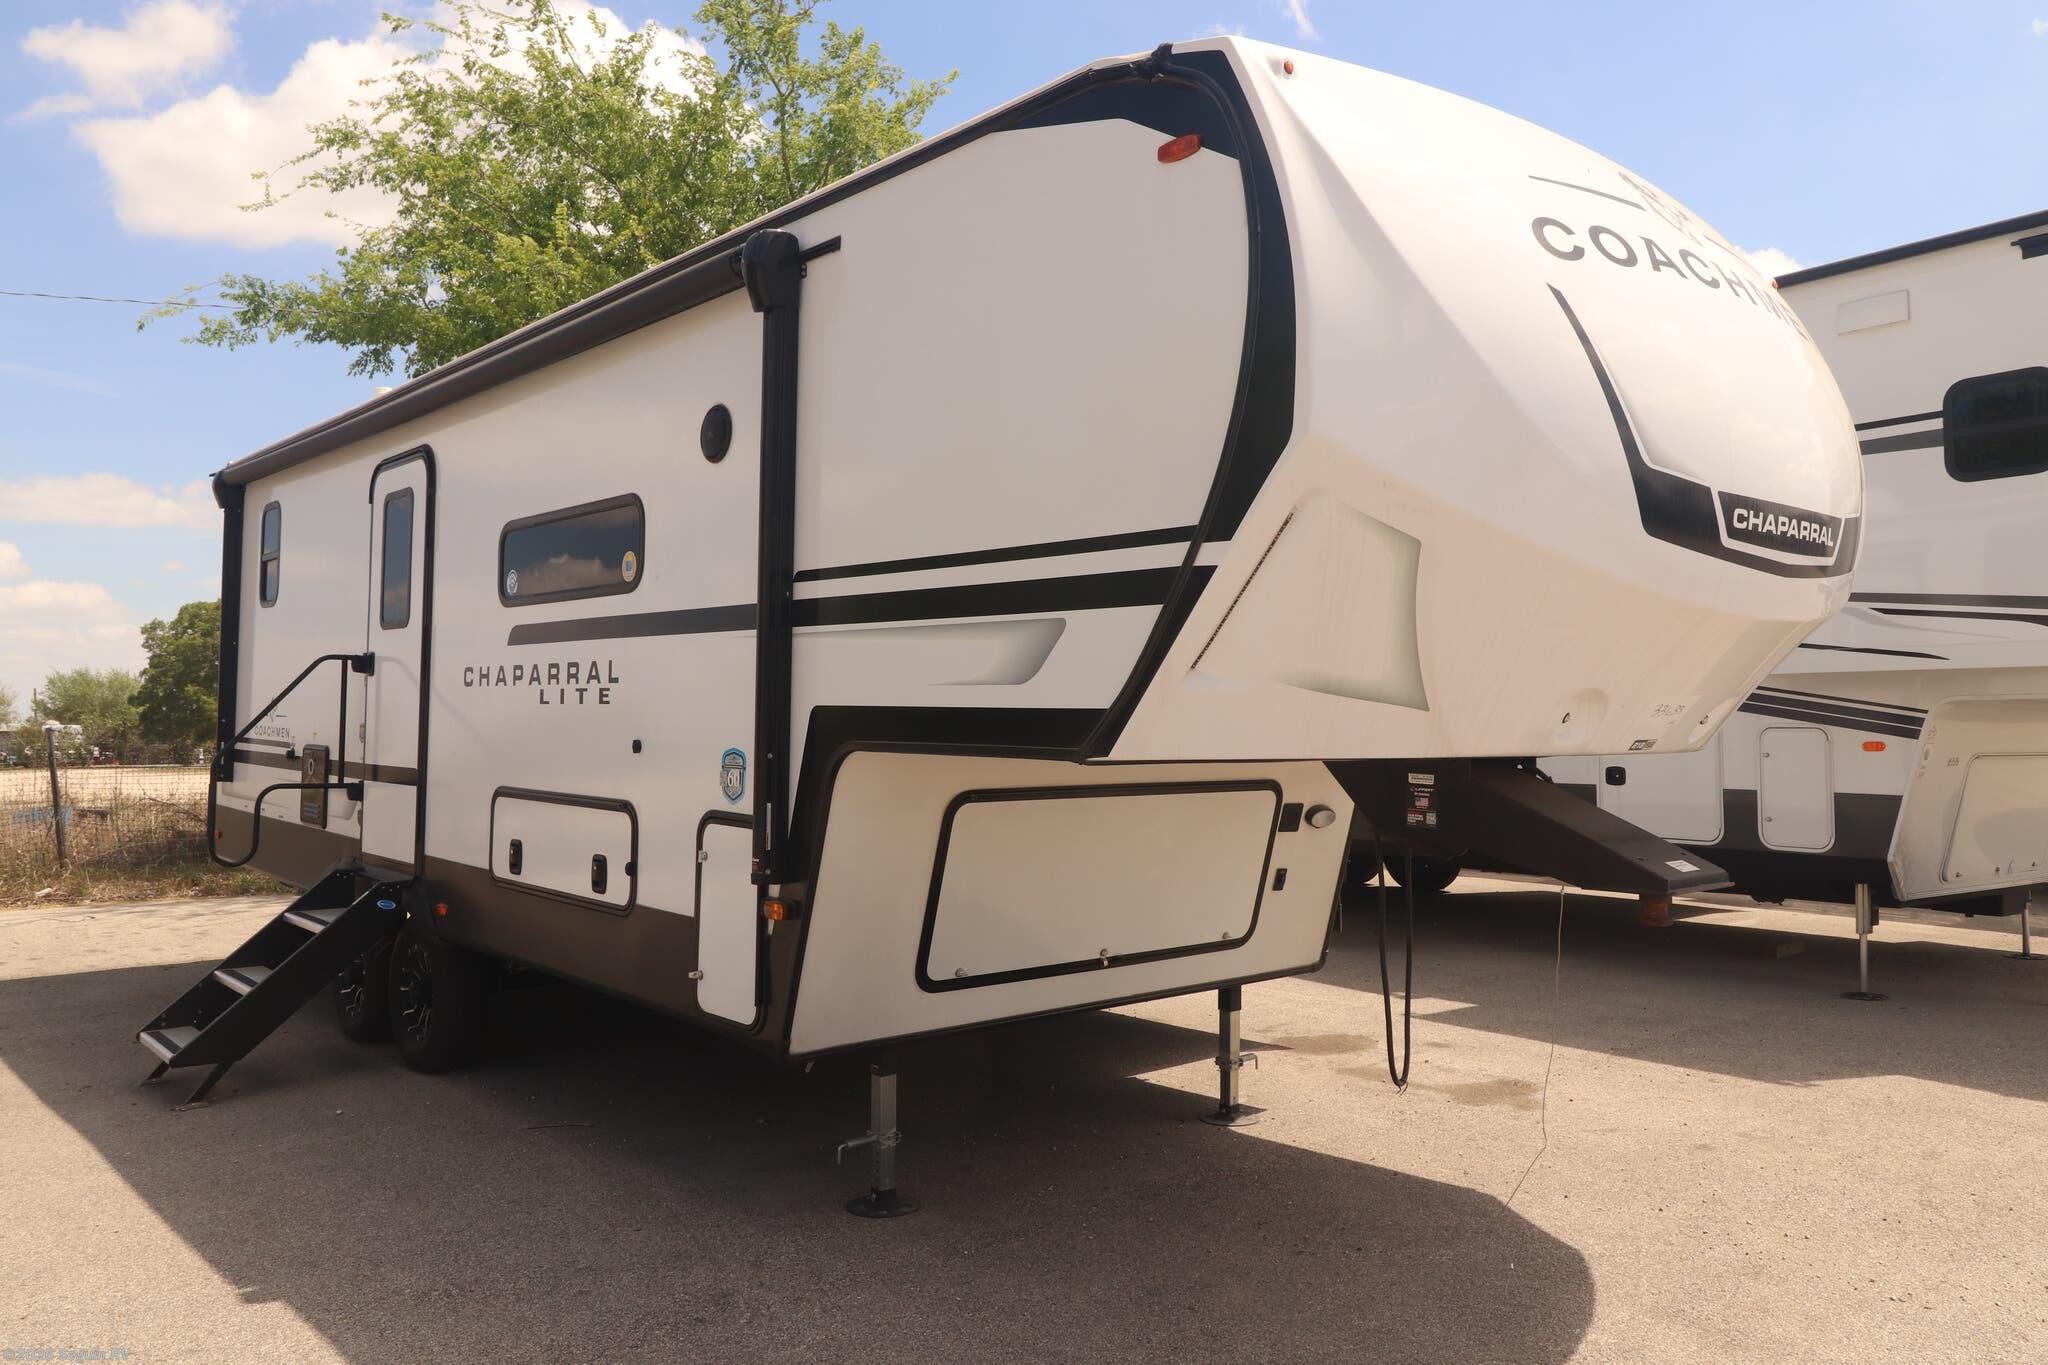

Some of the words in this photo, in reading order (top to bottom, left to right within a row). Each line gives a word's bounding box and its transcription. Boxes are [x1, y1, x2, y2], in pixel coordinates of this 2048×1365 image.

[1733, 508, 1834, 547] CHAPARRAL
[463, 660, 619, 687] CHAPARRAL
[539, 687, 611, 705] LITE
[254, 725, 290, 739] COACHMEN
